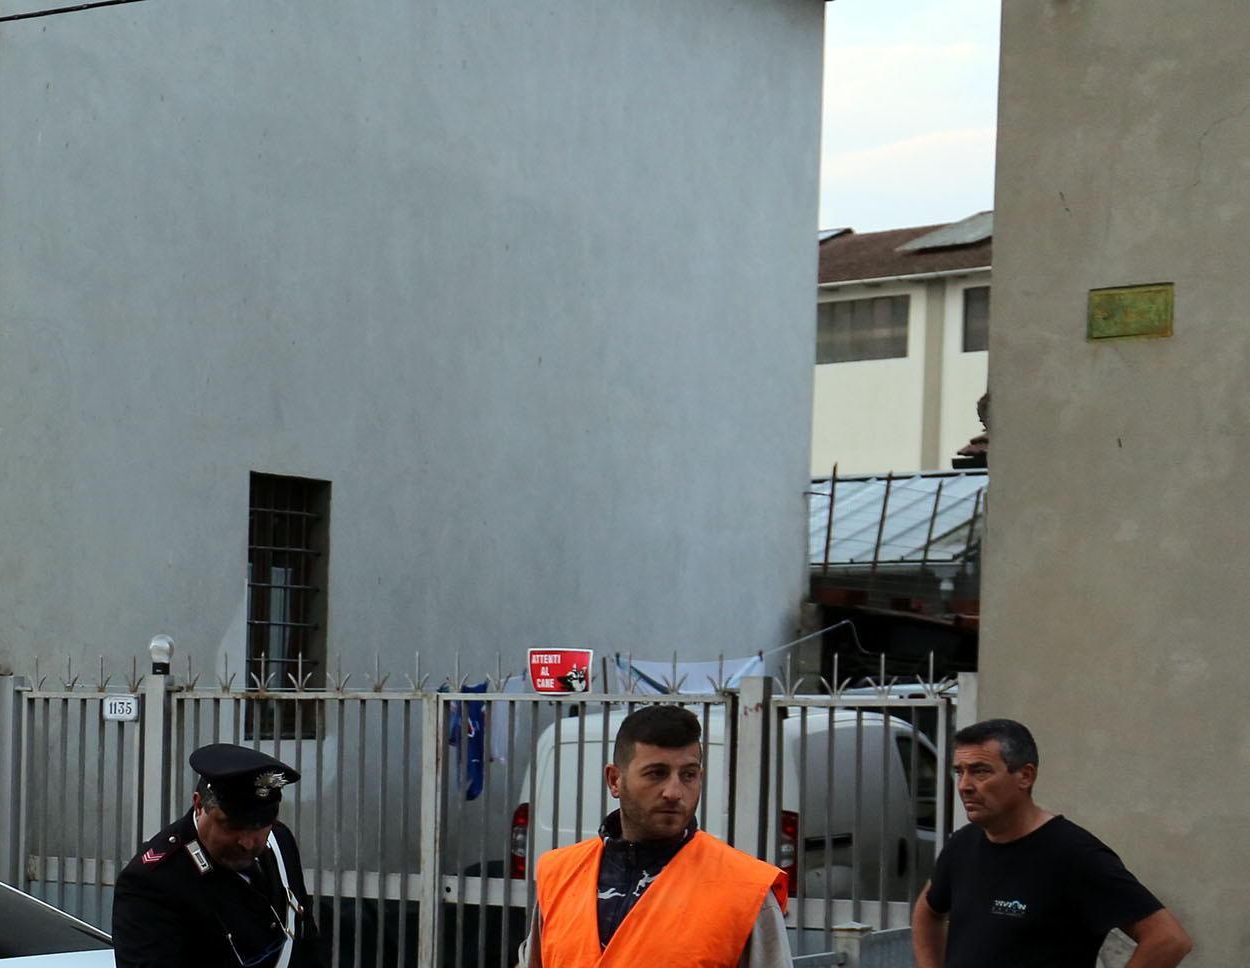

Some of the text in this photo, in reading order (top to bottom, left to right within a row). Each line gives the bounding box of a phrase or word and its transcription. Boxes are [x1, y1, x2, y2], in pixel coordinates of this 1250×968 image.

[531, 654, 561, 664] ATTENTI
[540, 666, 550, 676] AL
[536, 678, 555, 689] CANE
[109, 701, 132, 715] 1135
